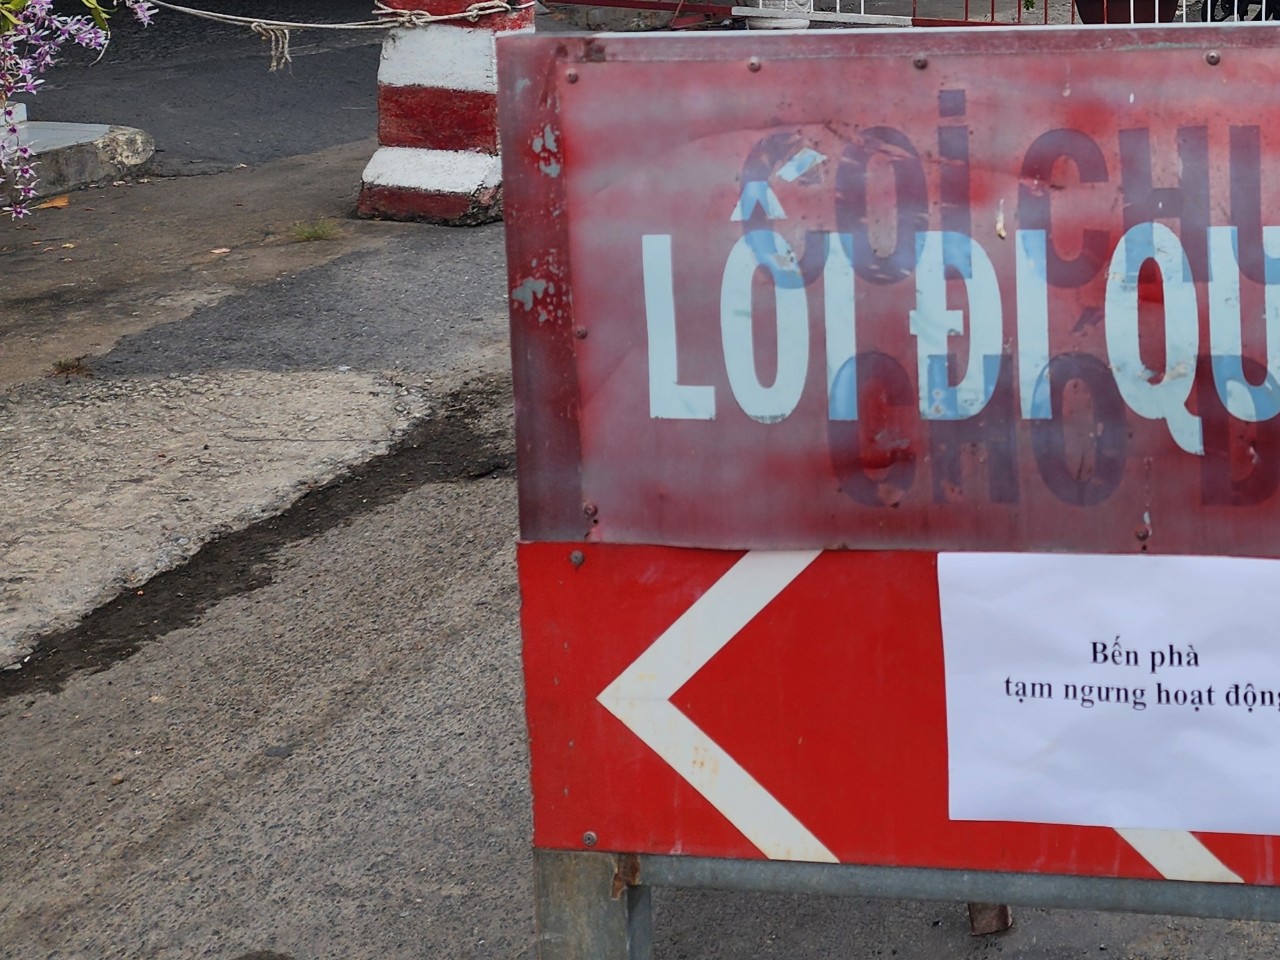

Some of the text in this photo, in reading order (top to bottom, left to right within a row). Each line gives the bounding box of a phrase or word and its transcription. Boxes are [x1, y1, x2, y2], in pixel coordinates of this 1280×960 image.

[642, 147, 859, 425] LỐI
[908, 227, 1053, 422] ĐI
[1090, 635, 1200, 674] Bến phà
[1004, 676, 1053, 704] tạm
[1063, 683, 1148, 711] ngưng
[1156, 682, 1216, 712] hoạt
